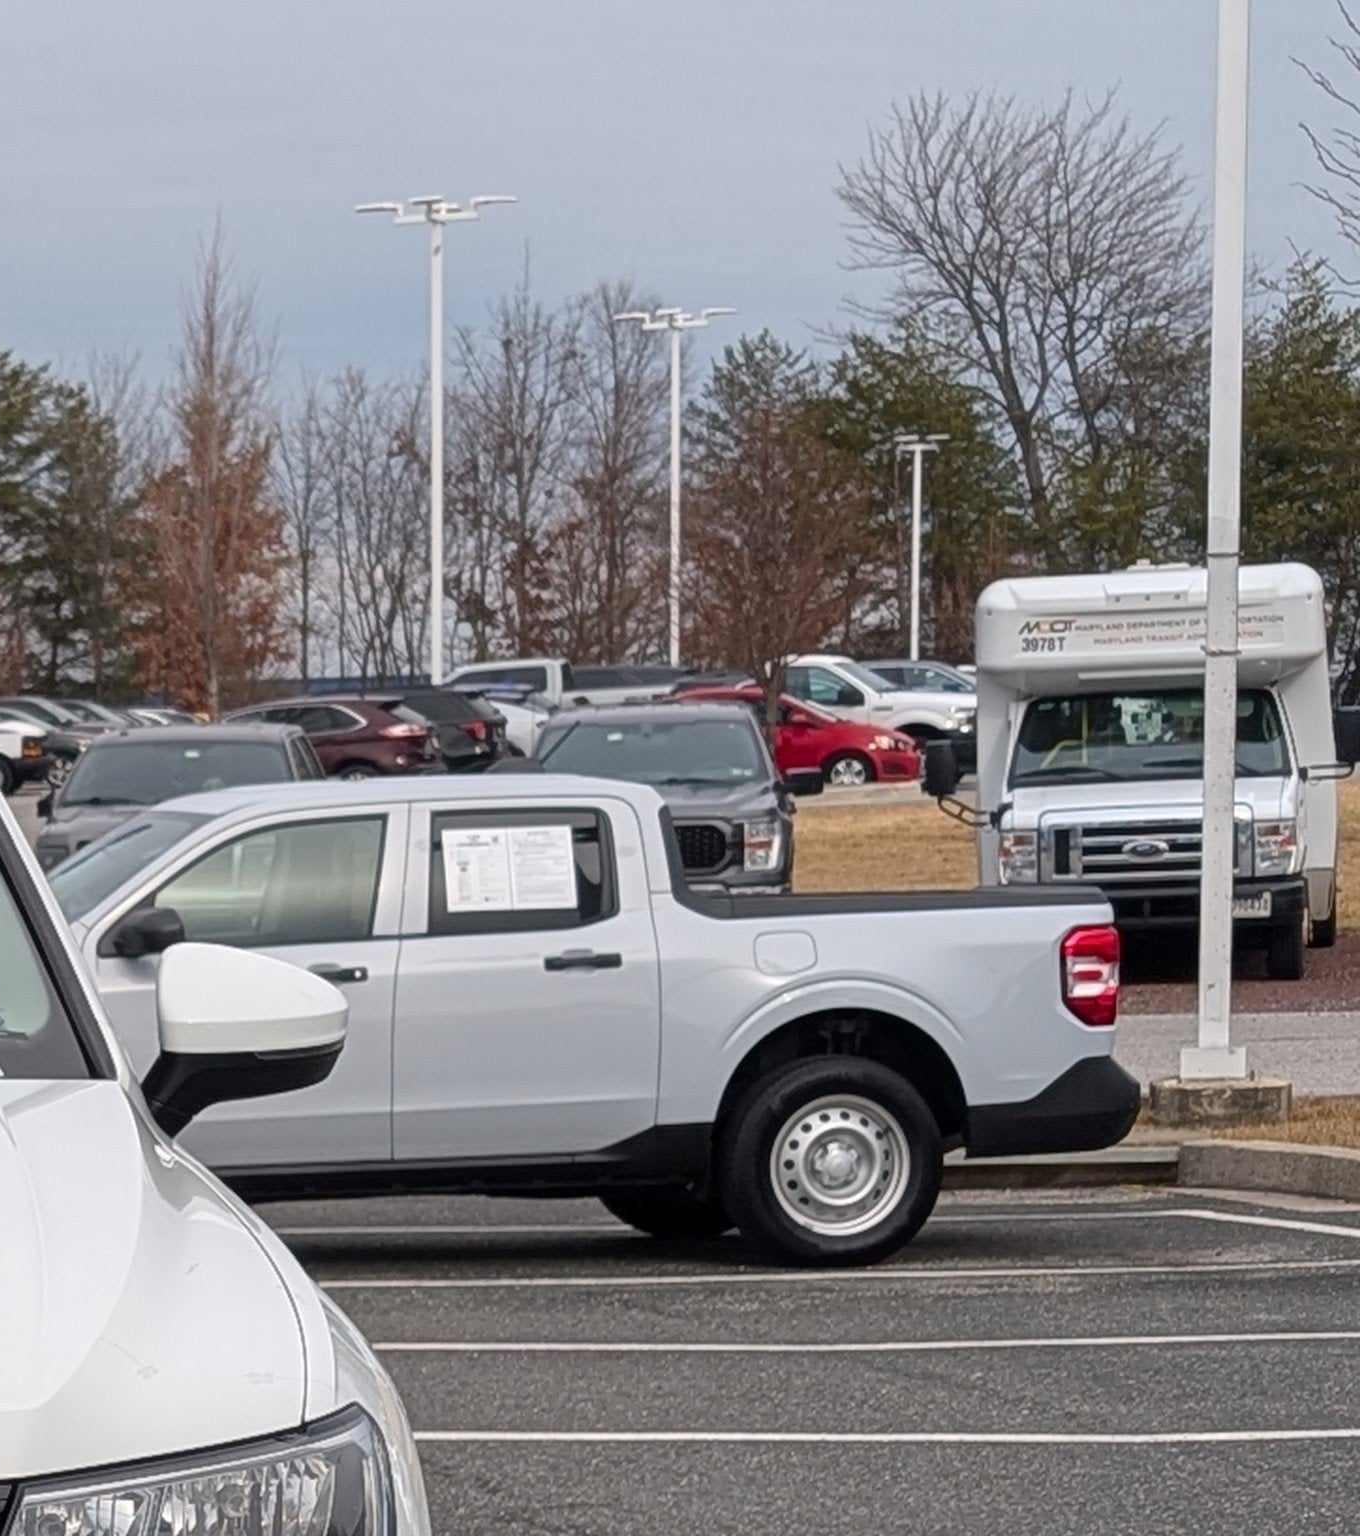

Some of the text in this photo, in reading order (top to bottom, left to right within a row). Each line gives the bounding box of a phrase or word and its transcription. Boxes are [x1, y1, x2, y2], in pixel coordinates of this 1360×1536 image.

[1074, 622, 1125, 632] MARYLAND
[1126, 619, 1186, 630] DEPARTMENT
[1188, 618, 1201, 627] OF
[1021, 636, 1067, 652] 3978T
[1092, 635, 1144, 645] MARYLAND
[1146, 633, 1184, 643] TRANSIT
